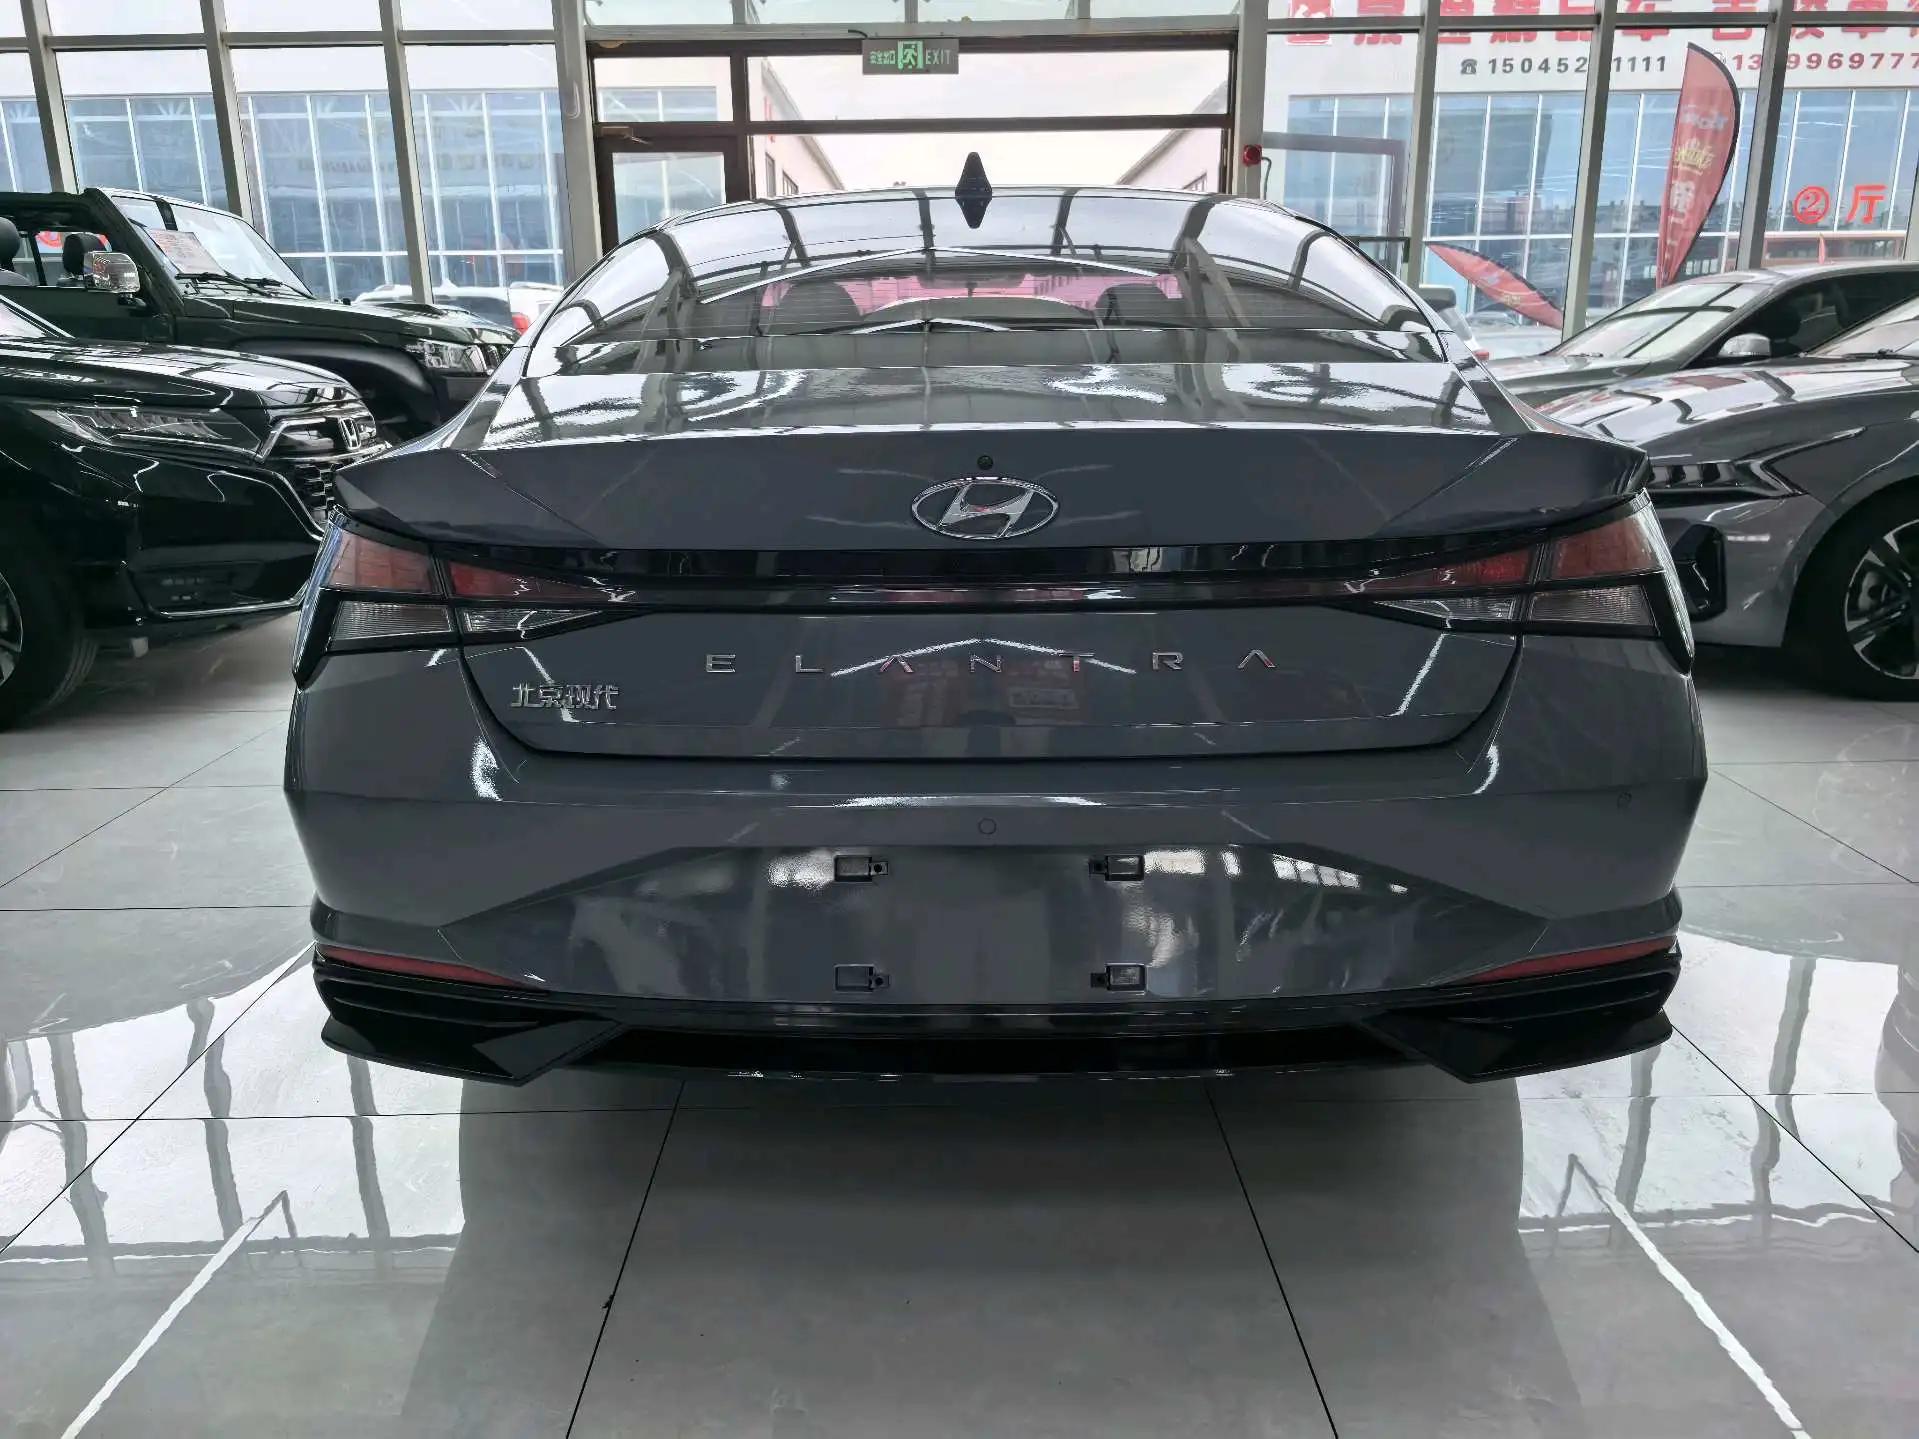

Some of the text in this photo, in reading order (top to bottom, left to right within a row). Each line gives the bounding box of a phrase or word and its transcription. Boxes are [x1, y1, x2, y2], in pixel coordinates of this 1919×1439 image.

[925, 49, 951, 65] EXIT
[1488, 55, 1666, 75] 1504521111
[1732, 52, 1919, 70] 139969777
[705, 649, 1276, 673] ELANTRA
[510, 682, 619, 710] 北京现代
